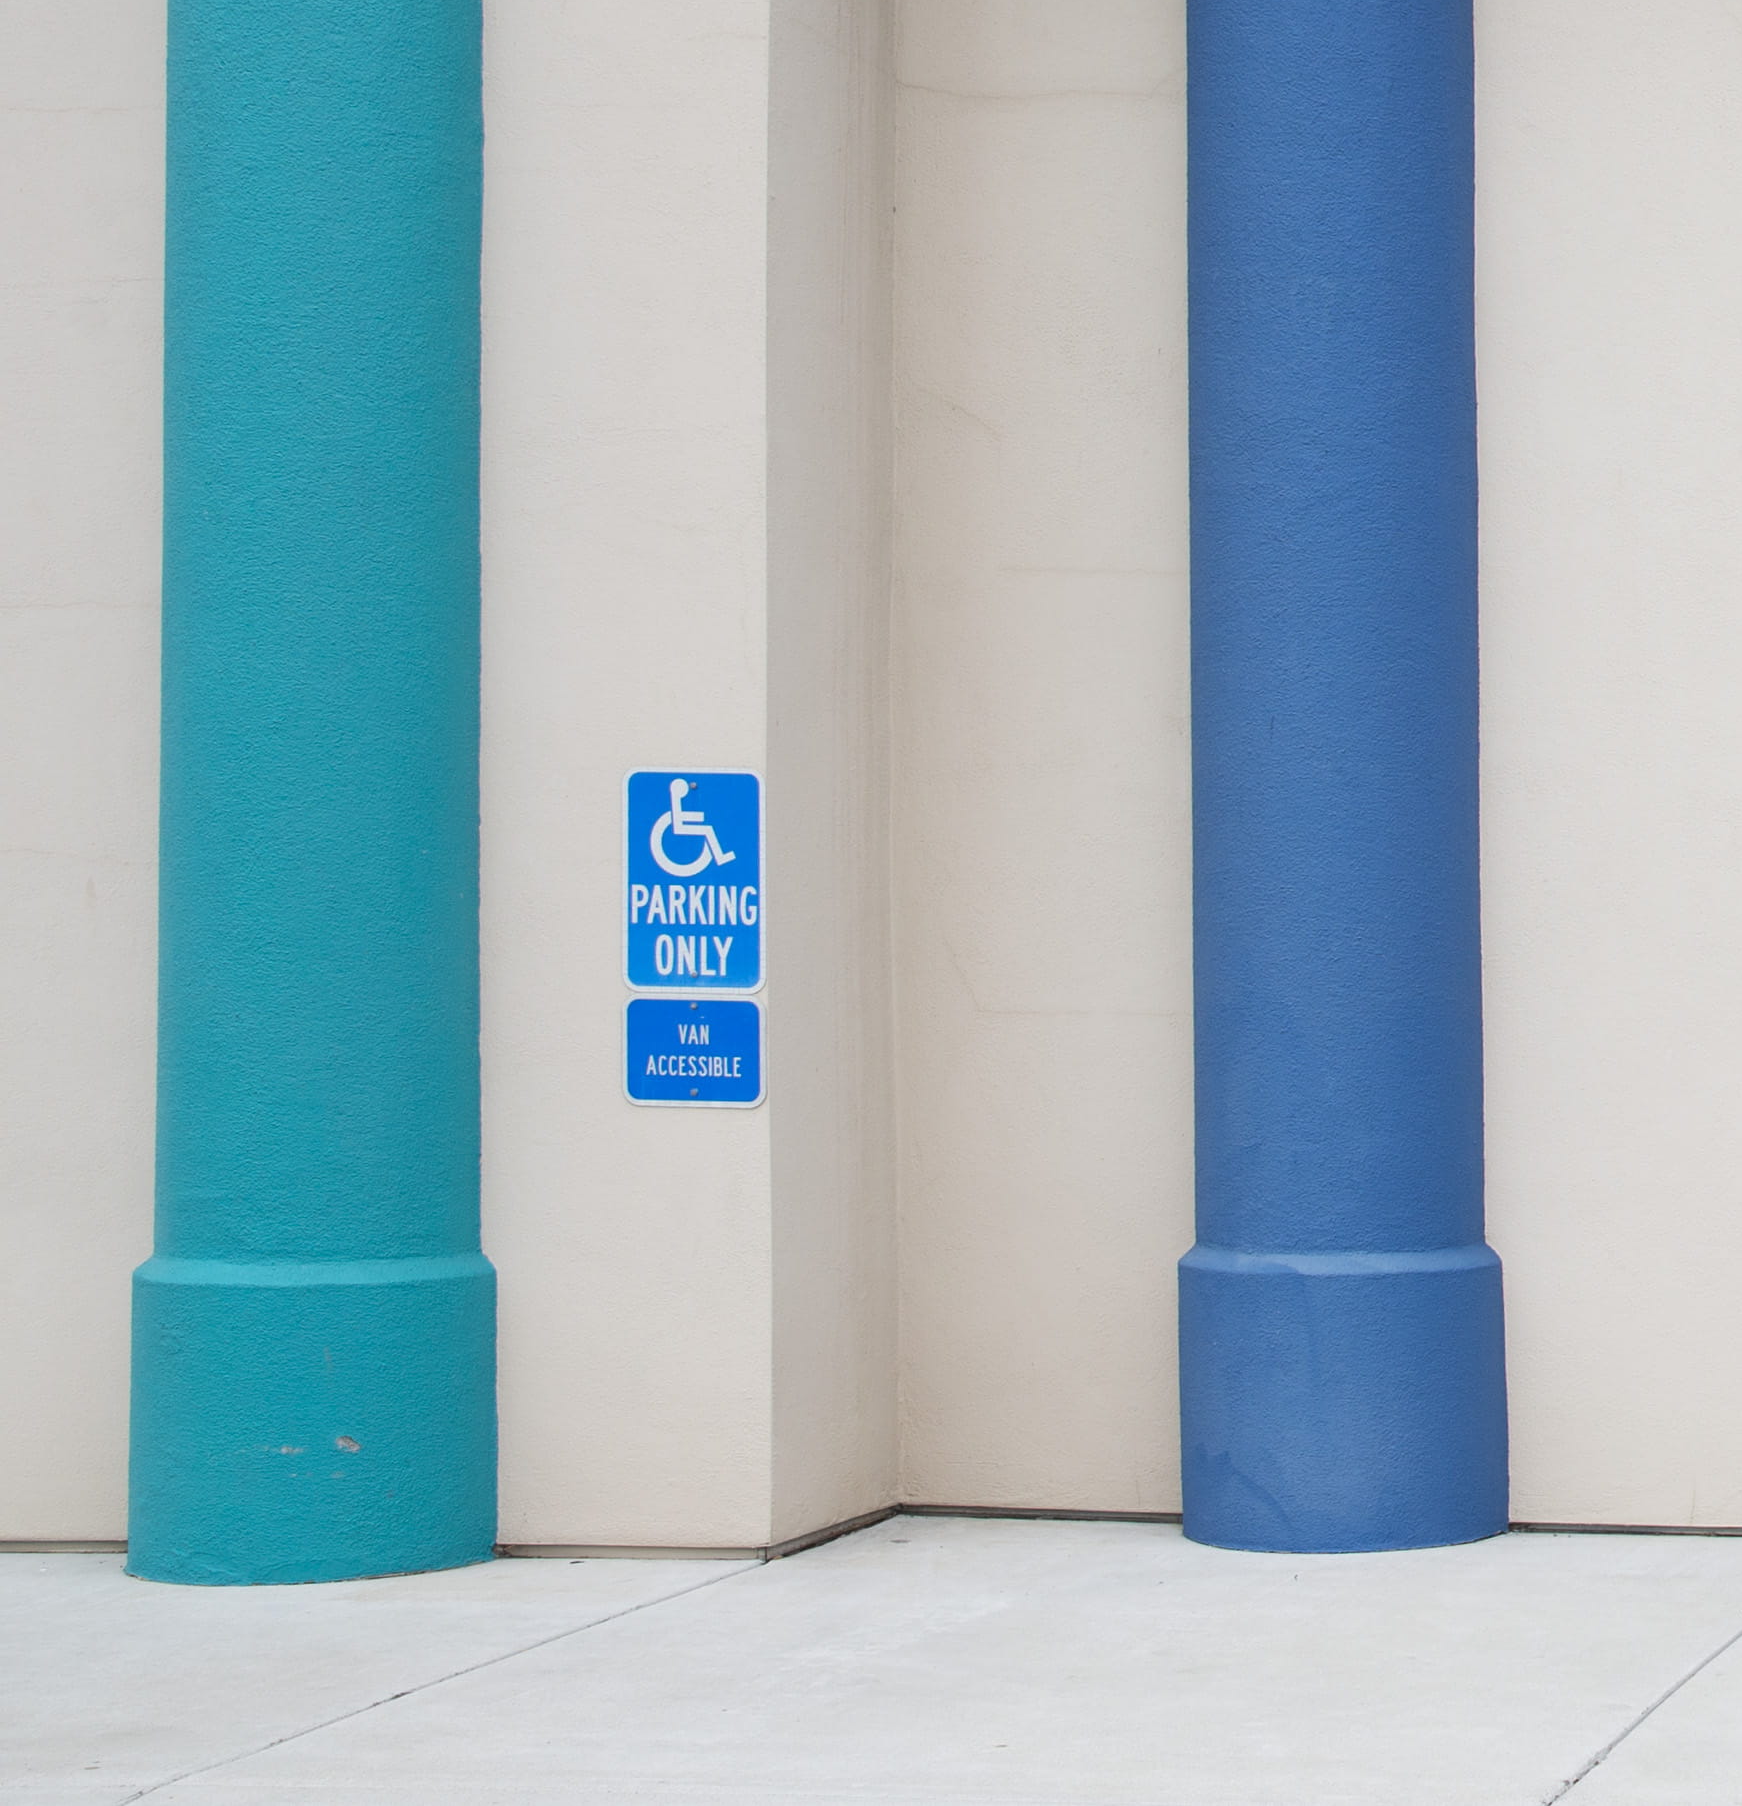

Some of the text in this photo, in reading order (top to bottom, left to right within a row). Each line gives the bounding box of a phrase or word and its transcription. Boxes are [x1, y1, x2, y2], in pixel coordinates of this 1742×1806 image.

[630, 884, 758, 926] PARKING
[655, 934, 734, 976] ONLY
[677, 1024, 710, 1045] VAN
[646, 1055, 742, 1078] ACCESSIBLE
